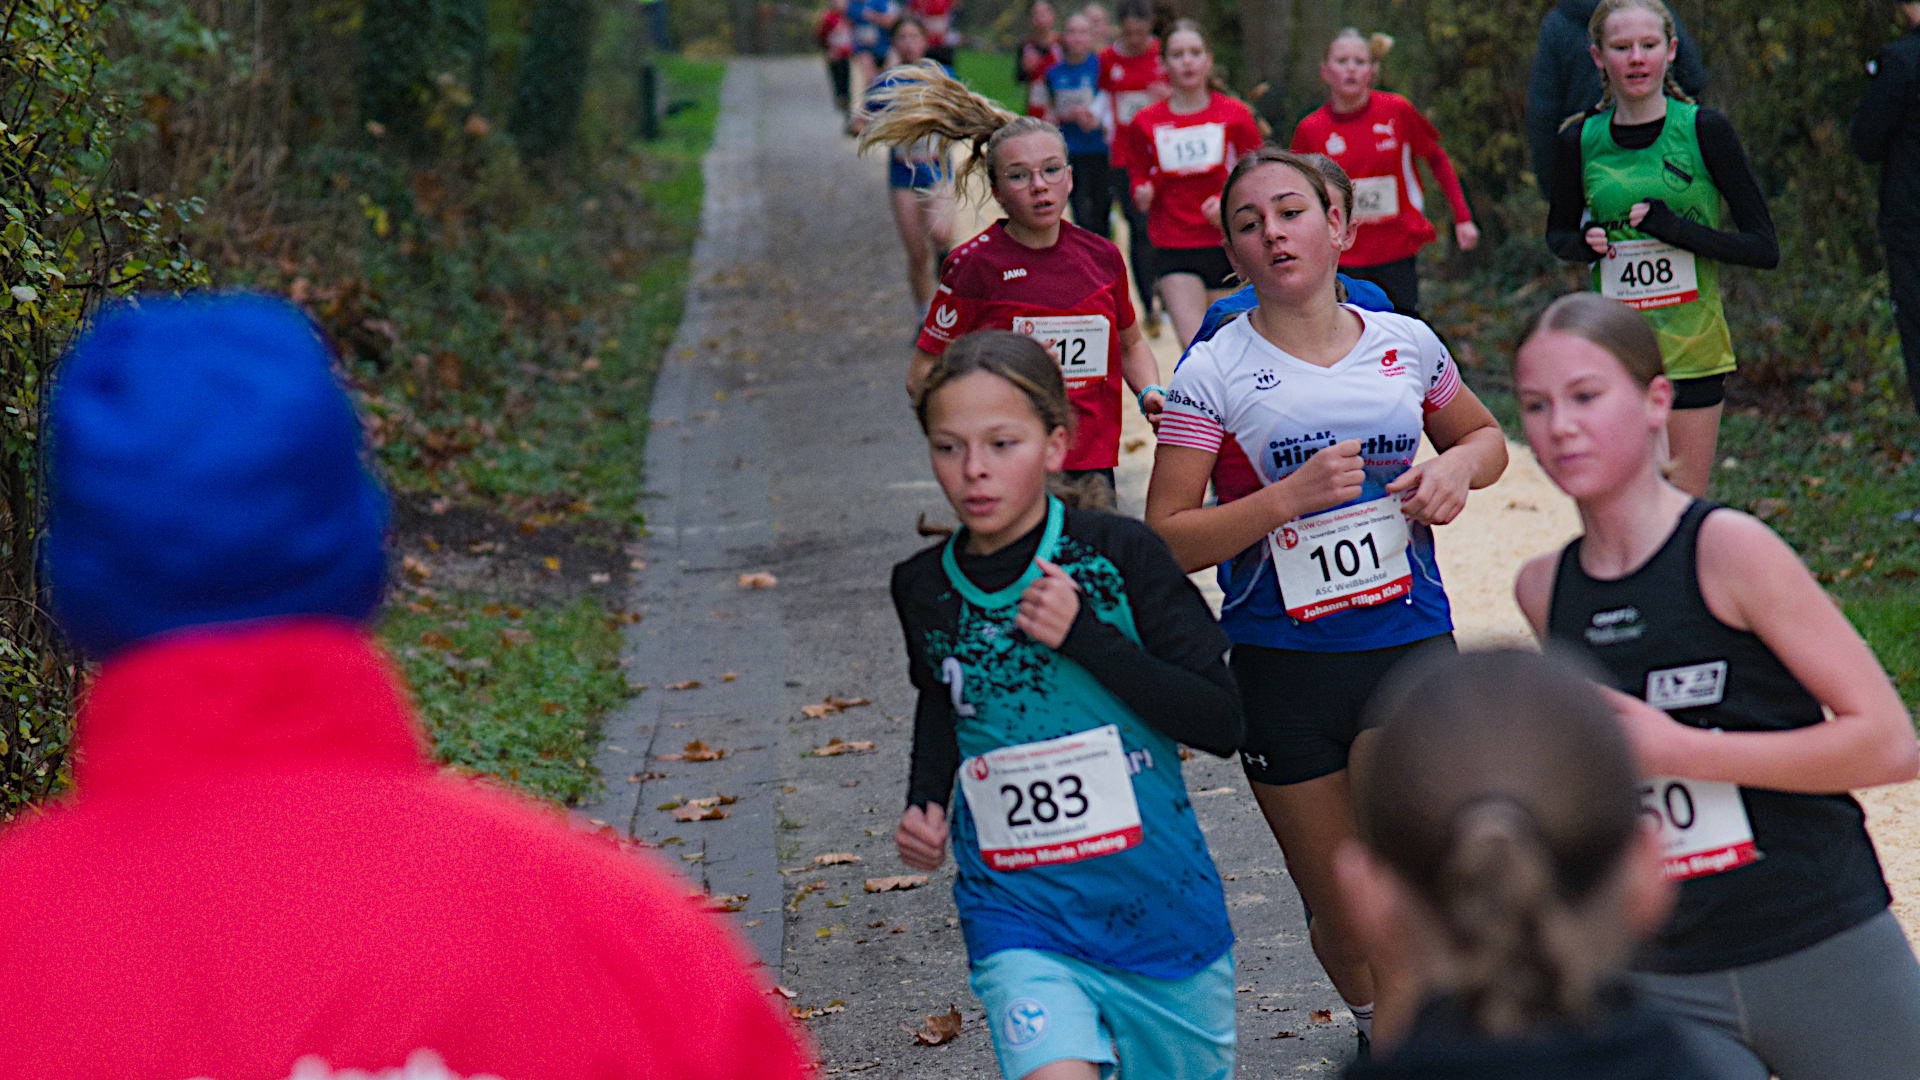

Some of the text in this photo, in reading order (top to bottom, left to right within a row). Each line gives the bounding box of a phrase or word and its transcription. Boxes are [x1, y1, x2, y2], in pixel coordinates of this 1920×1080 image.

[1174, 140, 1208, 160] 153
[1003, 267, 1027, 281] JAKO
[1620, 257, 1674, 288] 408
[1272, 434, 1416, 469] Hinrthür
[1310, 532, 1380, 583] 101
[1303, 583, 1402, 619] Johanna Filipa Klein
[1315, 571, 1387, 596] ASC Weißbachtal
[942, 656, 976, 717] 2
[1000, 775, 1089, 827] 283
